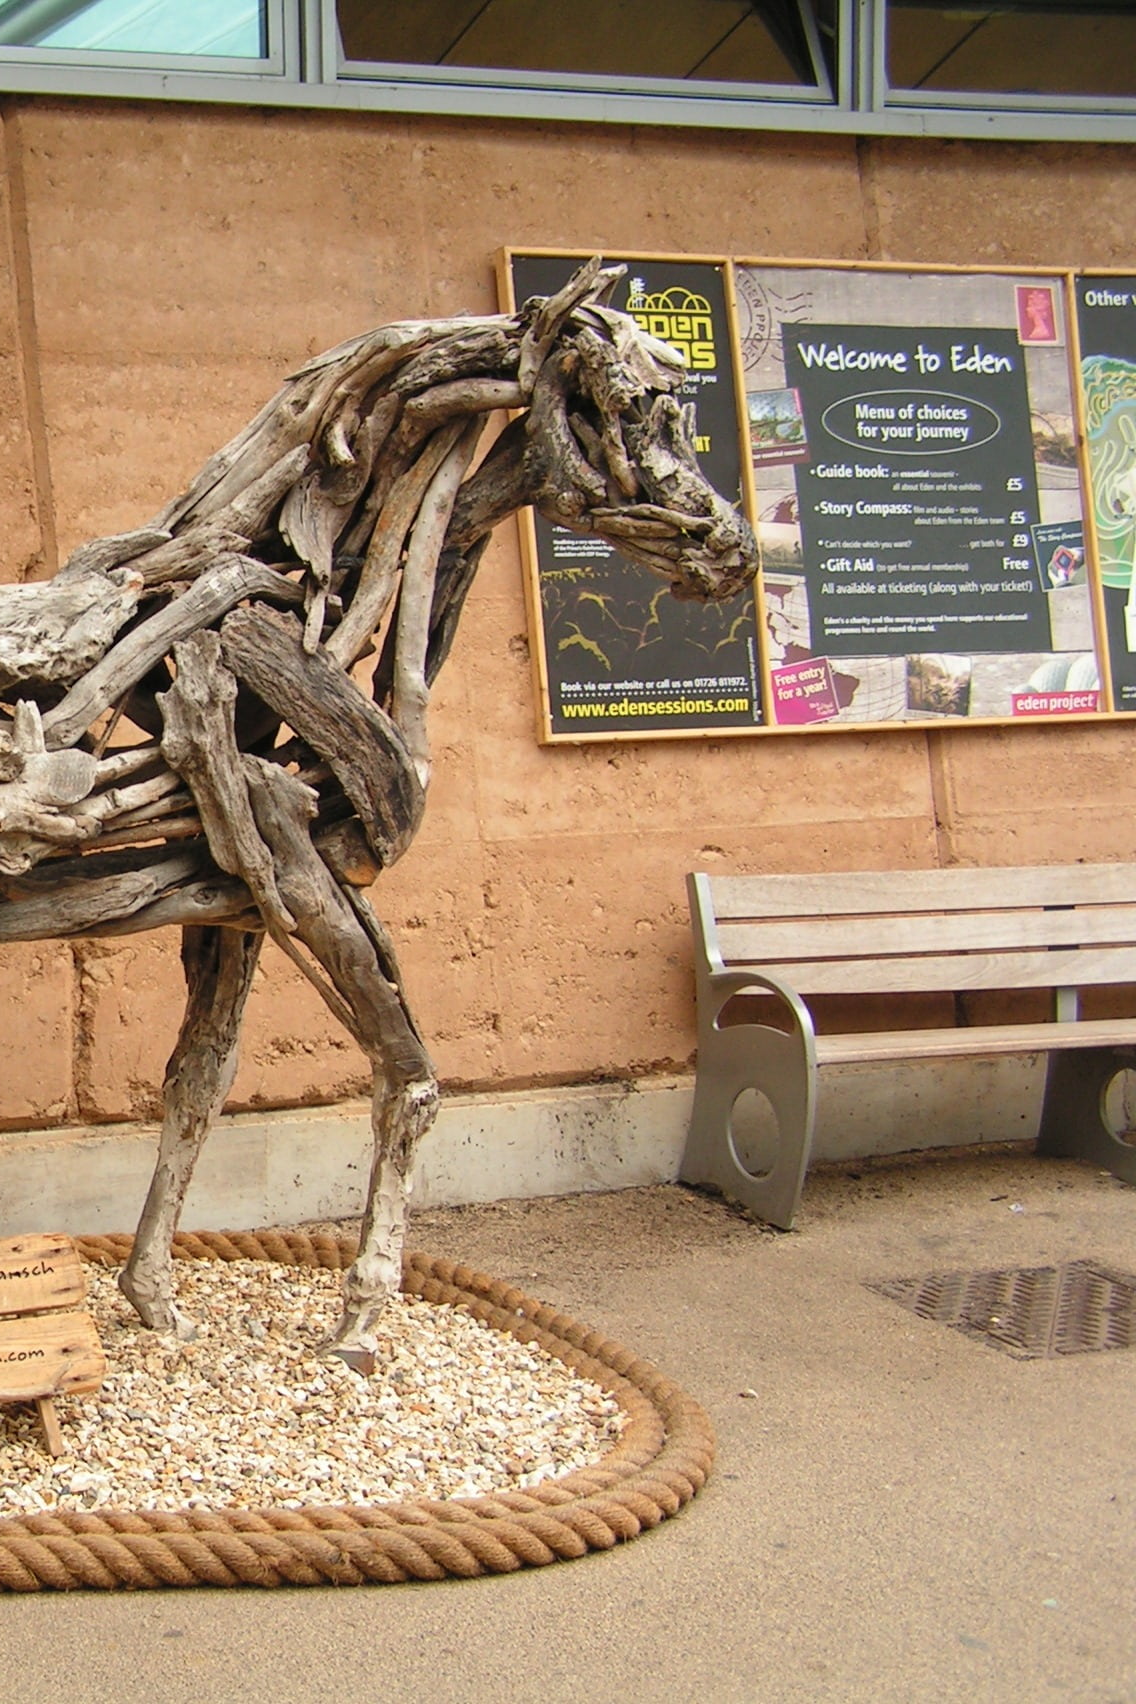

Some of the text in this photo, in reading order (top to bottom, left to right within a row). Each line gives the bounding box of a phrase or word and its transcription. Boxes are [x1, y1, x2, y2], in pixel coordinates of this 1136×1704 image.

[1085, 290, 1129, 307] Other
[798, 342, 1012, 374] Welcome to Eden
[855, 404, 968, 420] Menu of choices
[857, 422, 969, 442] for your journey
[816, 464, 853, 478] Guide
[854, 464, 890, 478] book:
[1006, 478, 1023, 491] £5
[819, 501, 853, 517] Story
[856, 500, 913, 517] Compass:
[1009, 511, 1026, 525] £5
[1012, 534, 1028, 547] £9
[826, 558, 851, 572] Gift
[853, 558, 874, 572] Aid
[1003, 557, 1029, 570] Free
[821, 582, 834, 594] All
[836, 582, 876, 594] available
[877, 584, 887, 594] at
[888, 582, 927, 596] ticketing
[929, 581, 957, 596] (along
[958, 581, 978, 592] with
[980, 583, 999, 595] your
[561, 682, 582, 691] Book
[583, 682, 596, 691] via
[614, 680, 643, 690] website
[646, 682, 654, 690] or
[656, 679, 670, 689] call
[671, 681, 681, 689] us
[683, 680, 693, 688] on
[694, 678, 717, 687] 01726
[774, 667, 825, 687] Free entry
[778, 679, 828, 701] for a year!
[562, 696, 749, 718] www.edensessions.com
[1016, 693, 1094, 712] eden project
